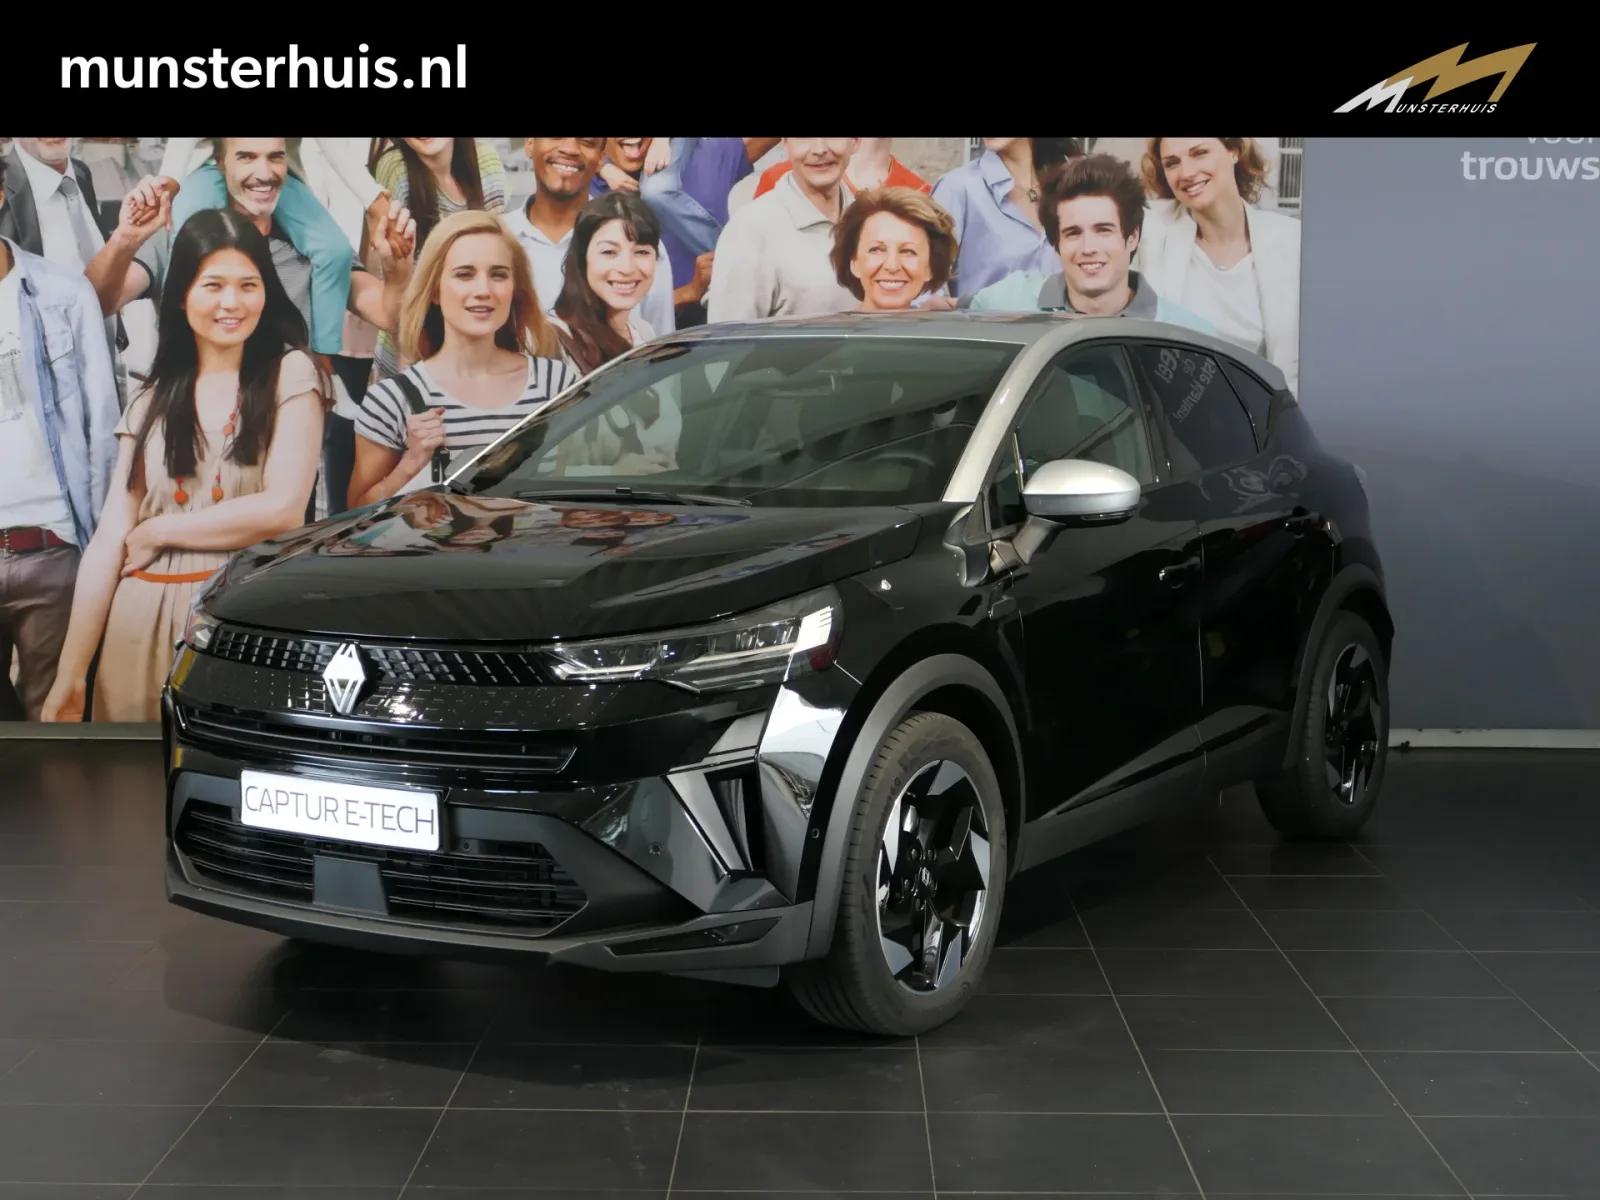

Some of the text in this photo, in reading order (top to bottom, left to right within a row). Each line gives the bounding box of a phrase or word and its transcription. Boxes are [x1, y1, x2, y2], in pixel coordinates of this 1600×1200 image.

[1460, 151, 1600, 181] trouws
[244, 785, 435, 836] CAPTUR E-TECH
